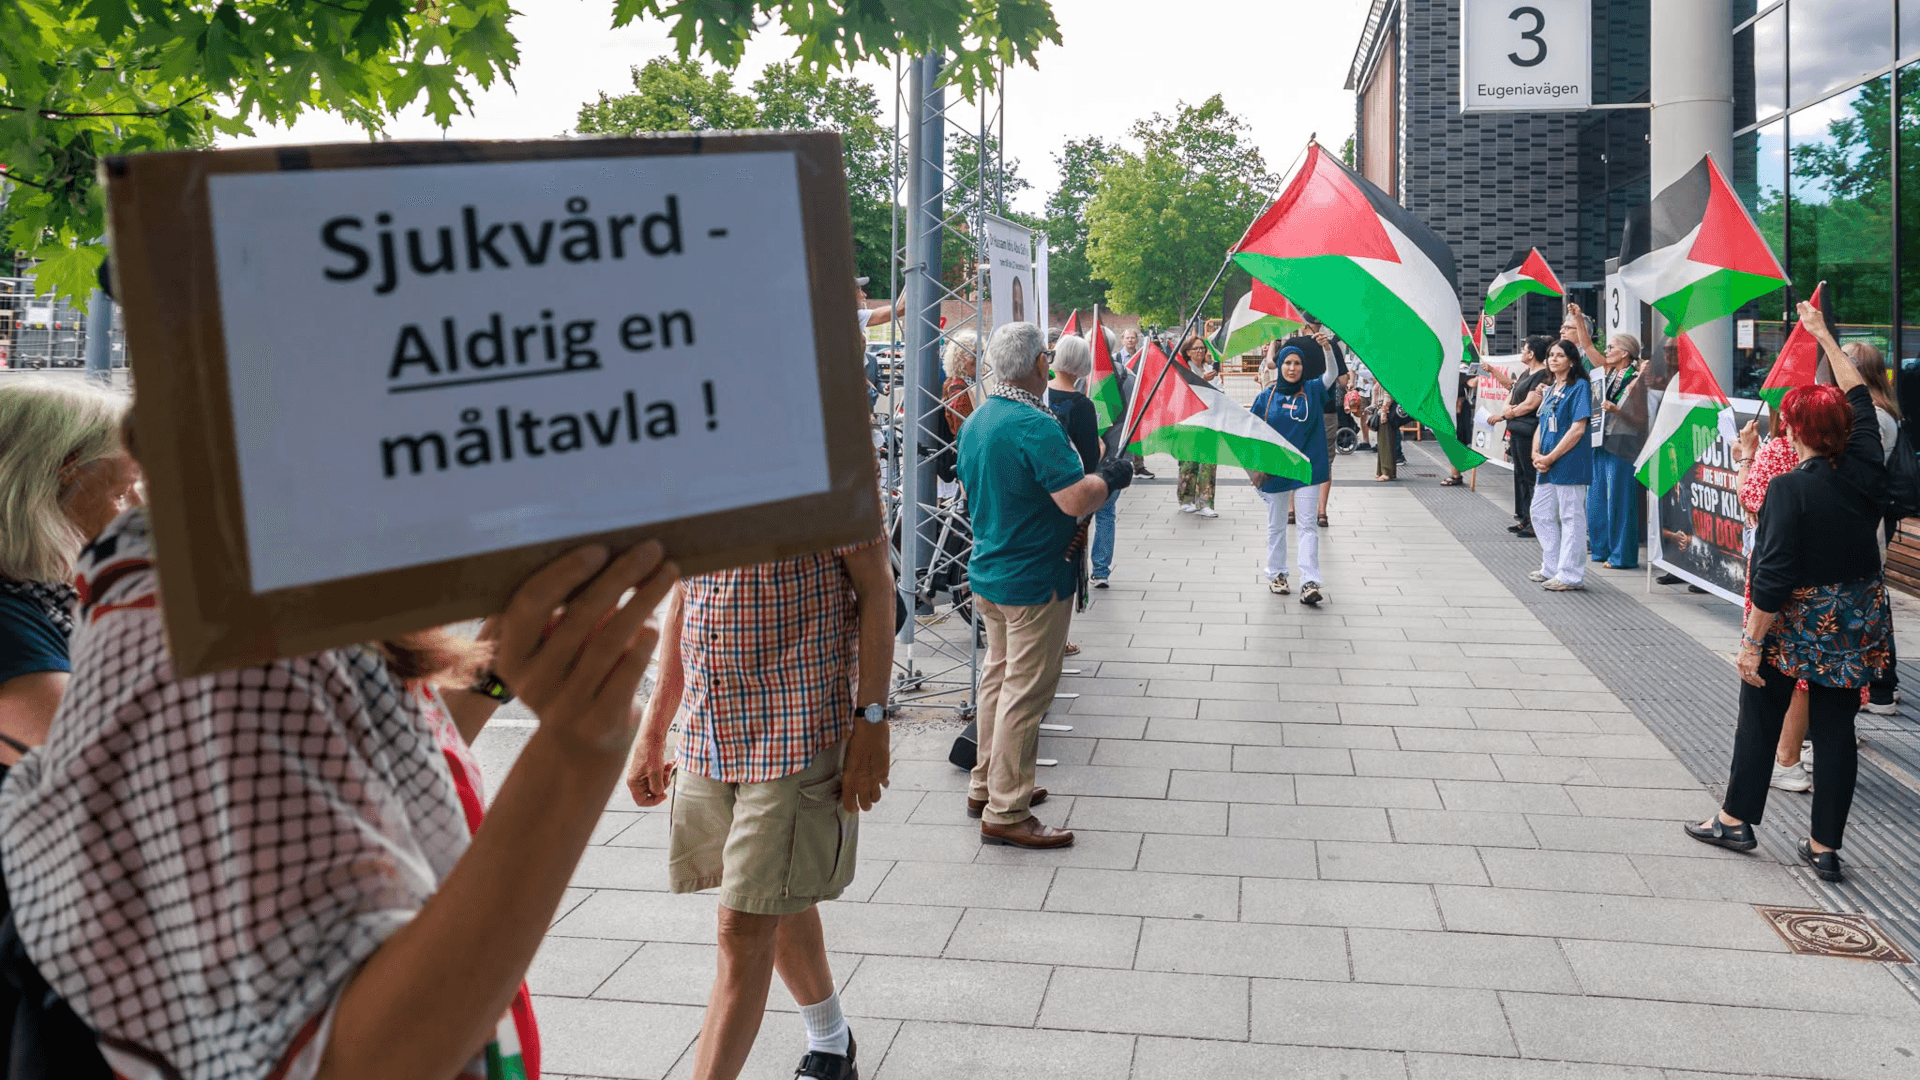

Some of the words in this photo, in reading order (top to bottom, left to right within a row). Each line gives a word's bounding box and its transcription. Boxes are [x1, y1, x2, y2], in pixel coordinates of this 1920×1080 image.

[1507, 6, 1548, 68] 3
[1478, 82, 1579, 99] Eugeniavägen
[320, 195, 684, 294] Sjukvård
[1612, 287, 1620, 329] 3
[387, 310, 603, 382] Aldrig
[619, 308, 695, 353] en
[379, 391, 679, 480] måltavla
[701, 380, 719, 431] !
[1690, 482, 1719, 513] STOP
[1728, 474, 1738, 490] TA
[1692, 508, 1713, 542] OUR
[1715, 516, 1743, 552] DOC
